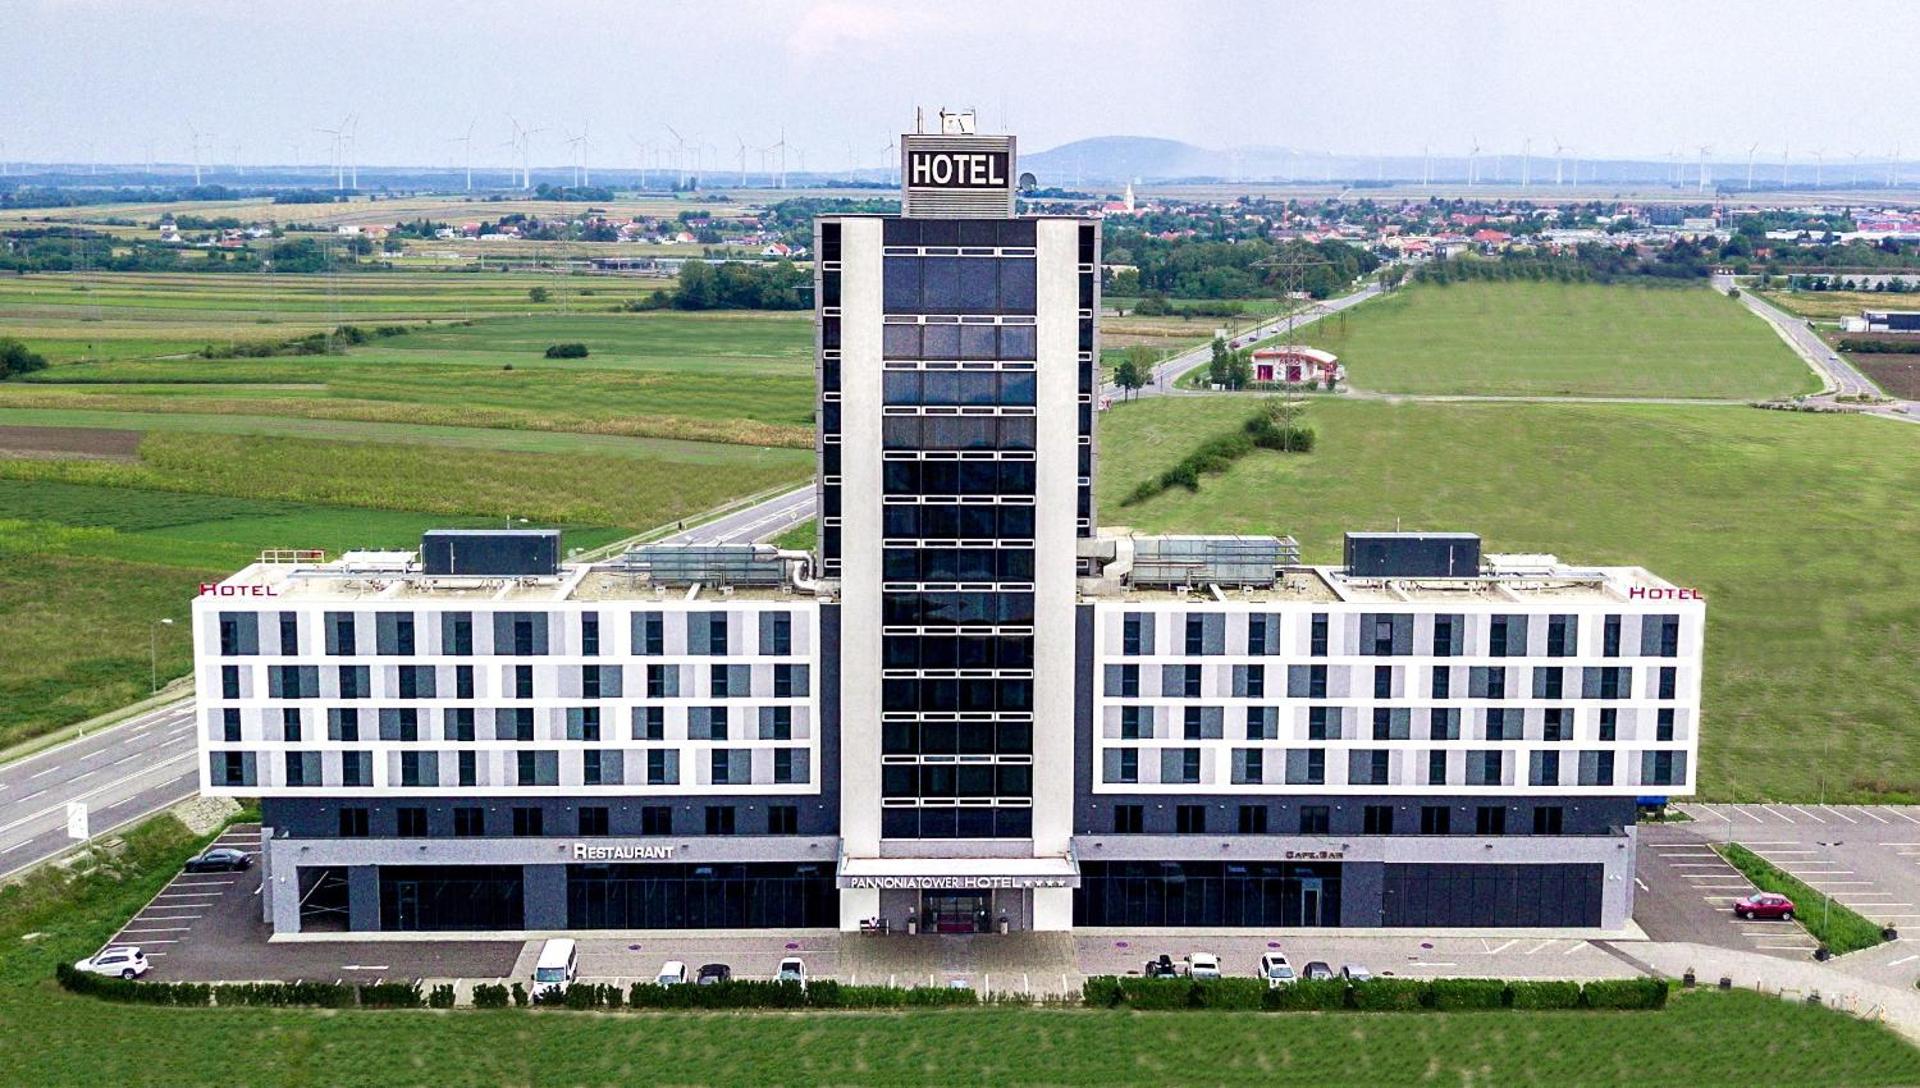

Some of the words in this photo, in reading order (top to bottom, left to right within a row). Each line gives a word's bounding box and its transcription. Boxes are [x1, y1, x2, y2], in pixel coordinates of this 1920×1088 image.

[912, 154, 1004, 185] HOTEL
[199, 582, 278, 596] HOTEL
[1629, 586, 1704, 600] HOTEL
[573, 843, 674, 859] RESTAURANT
[964, 876, 1022, 888] HOTEL
